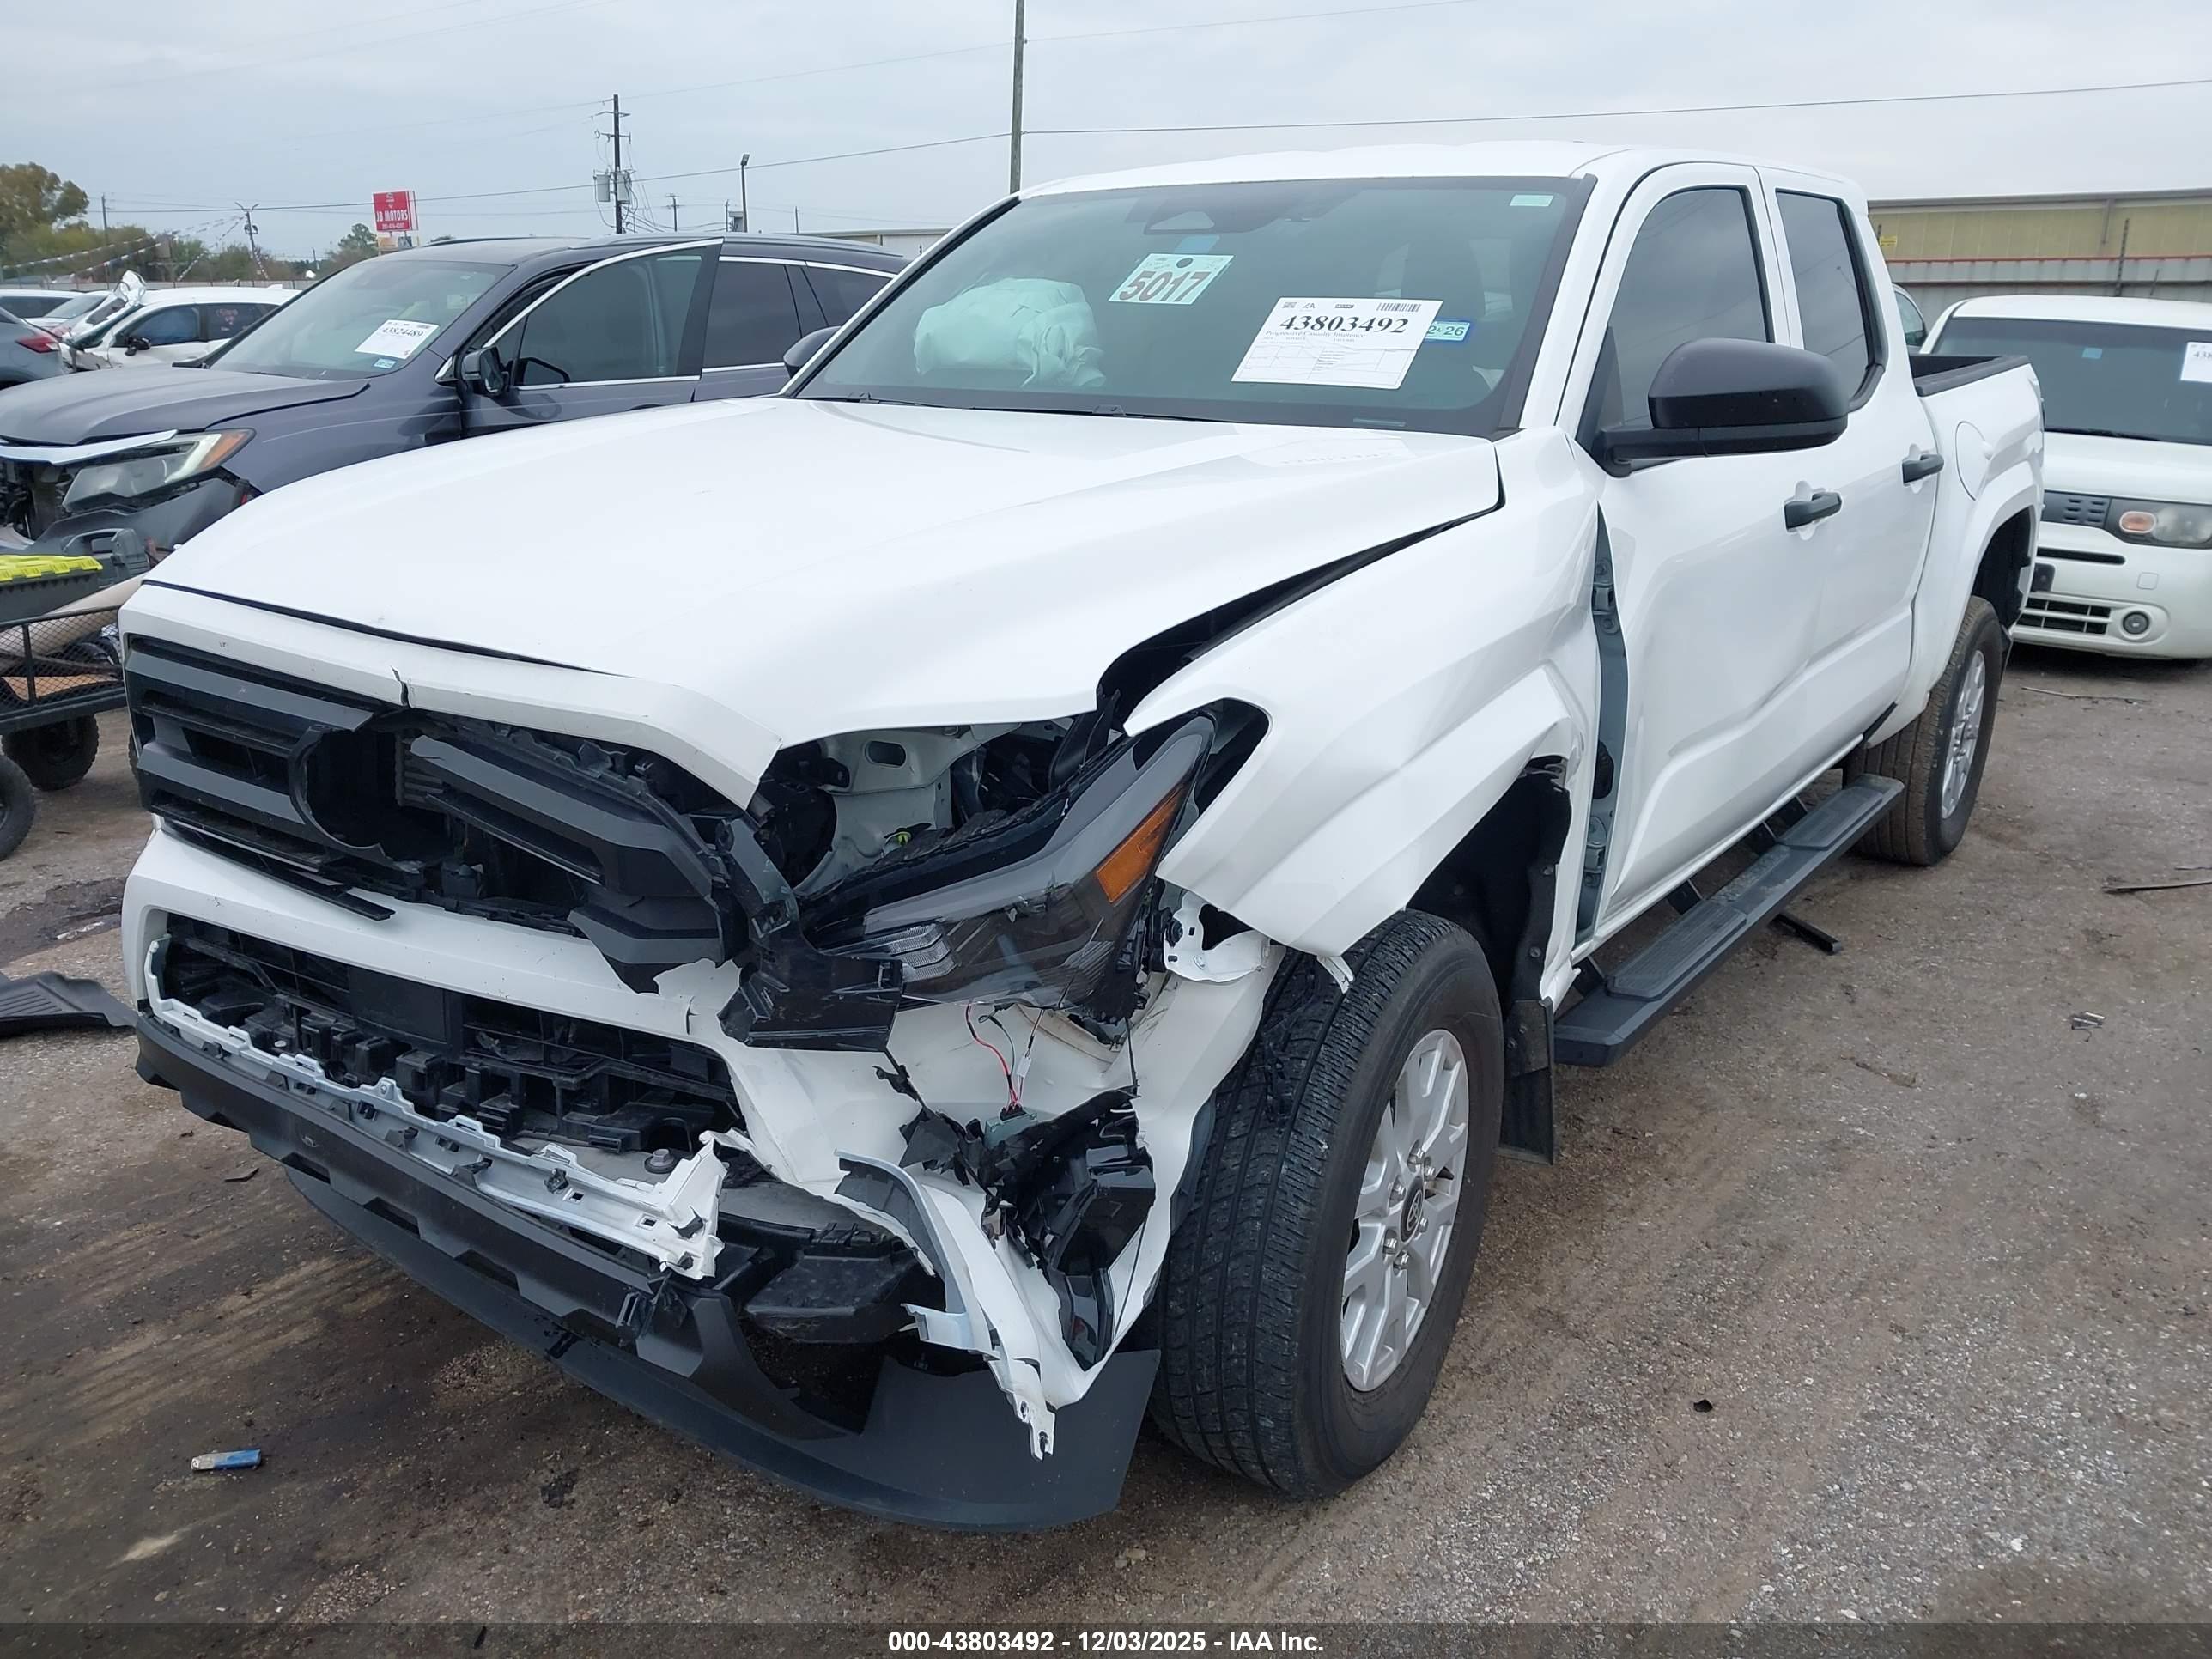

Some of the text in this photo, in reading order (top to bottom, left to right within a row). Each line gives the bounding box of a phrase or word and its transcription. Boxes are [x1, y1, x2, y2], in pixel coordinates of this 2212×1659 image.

[385, 210, 408, 221] MOTORS
[1119, 270, 1212, 302] 5017
[1279, 315, 1408, 333] 43803492
[1443, 325, 1465, 336] 26
